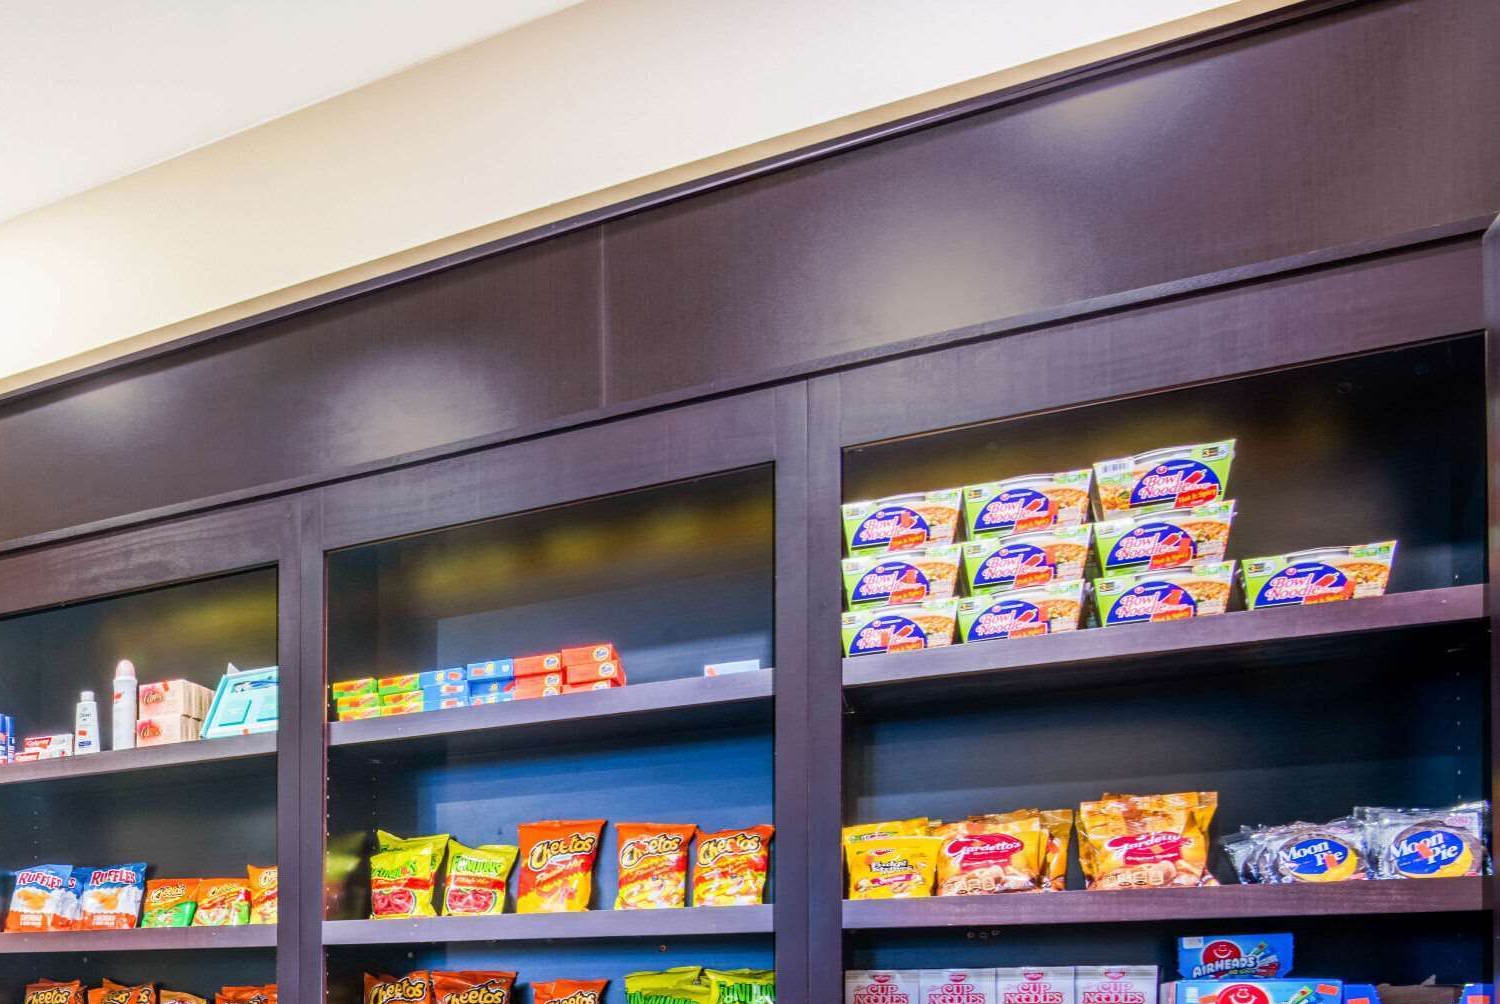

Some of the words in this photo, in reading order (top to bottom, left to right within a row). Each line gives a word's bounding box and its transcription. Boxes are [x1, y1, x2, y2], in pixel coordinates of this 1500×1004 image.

[528, 830, 597, 872] Cheetos
[946, 832, 1022, 862] Gardetto's
[1279, 838, 1330, 863] Moon
[17, 871, 62, 890] RUFFLES
[91, 868, 137, 887] RUFFLES
[1192, 954, 1258, 979] AIRHEADS
[866, 983, 899, 995] CUP
[941, 983, 974, 994] CUP
[1018, 982, 1051, 994] CUP
[1098, 981, 1133, 993] CUP
[1003, 992, 1064, 1004] NOODLES
[1082, 991, 1146, 1004] NOODLES
